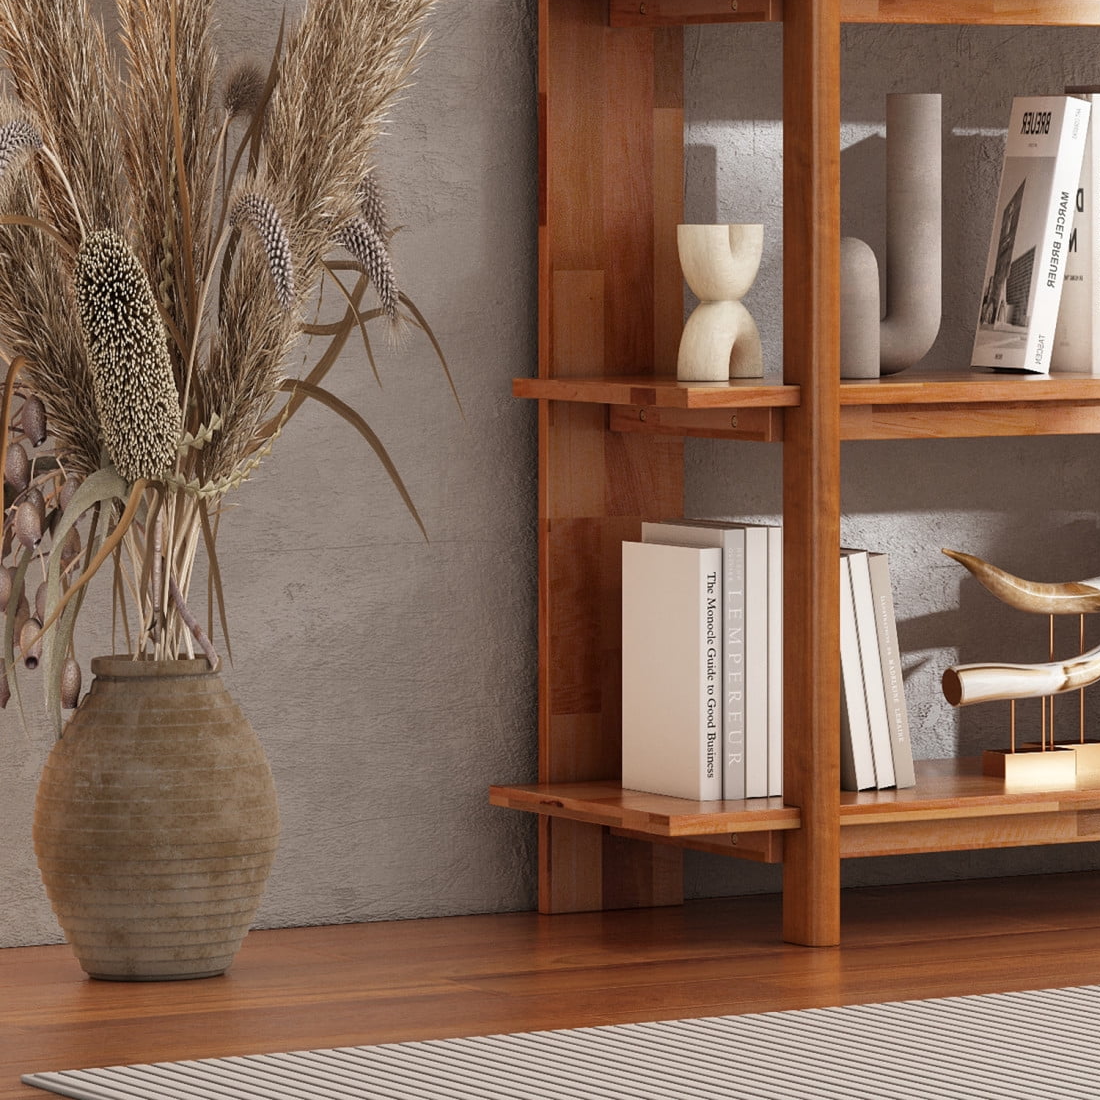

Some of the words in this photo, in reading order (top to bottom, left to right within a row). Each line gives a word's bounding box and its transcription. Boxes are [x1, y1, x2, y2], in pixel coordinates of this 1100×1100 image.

[706, 571, 717, 594] The
[706, 597, 717, 645] Monocle
[706, 647, 717, 682] Guide
[727, 589, 743, 767] LEMPEREUR
[706, 684, 716, 696] to
[706, 698, 717, 729] Good
[706, 732, 717, 779] Business
